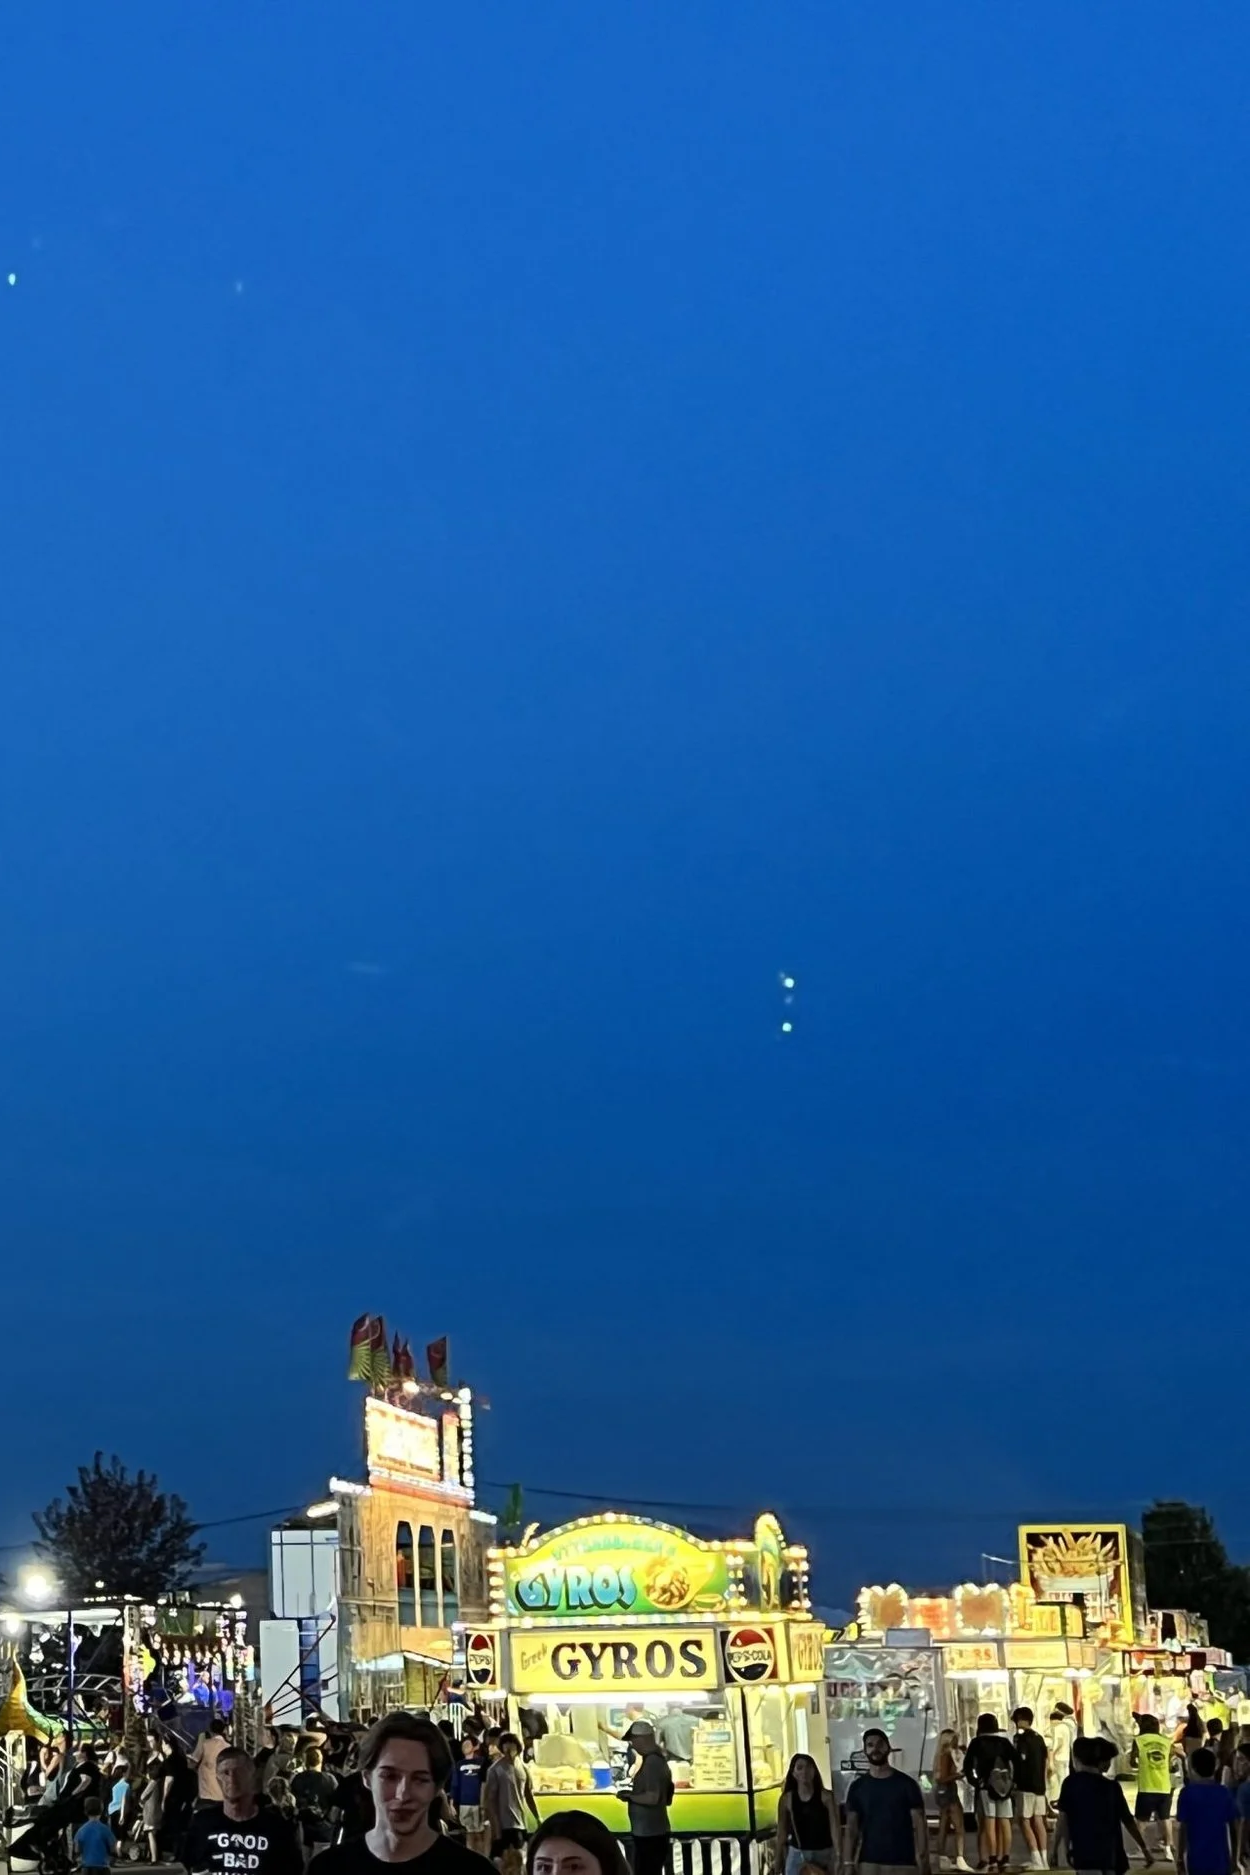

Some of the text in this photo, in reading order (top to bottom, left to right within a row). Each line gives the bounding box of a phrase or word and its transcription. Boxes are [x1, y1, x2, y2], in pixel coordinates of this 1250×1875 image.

[515, 1565, 638, 1611] GYROS
[520, 1639, 708, 1680] Greek GYROS
